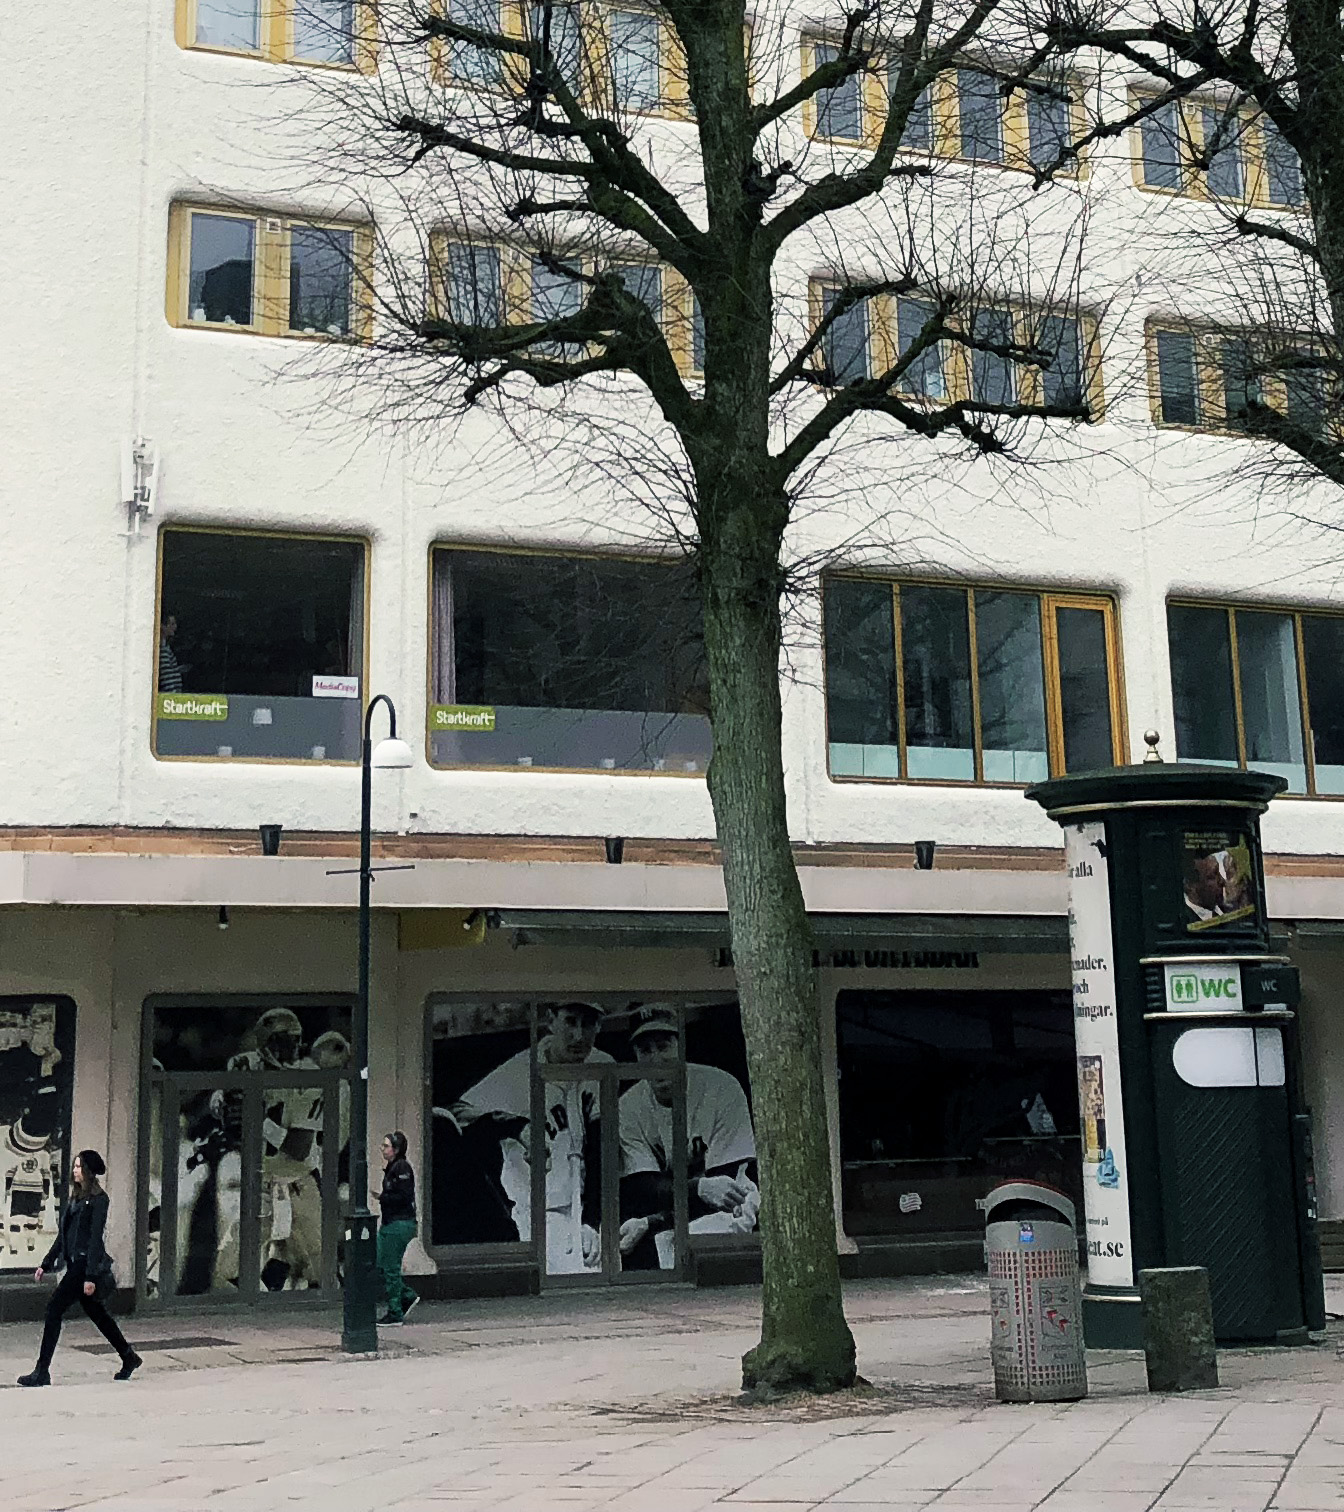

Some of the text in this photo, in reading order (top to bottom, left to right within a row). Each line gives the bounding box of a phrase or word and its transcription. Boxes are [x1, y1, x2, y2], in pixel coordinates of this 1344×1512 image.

[163, 699, 229, 716] Startkraft
[1200, 977, 1237, 999] WC
[1261, 979, 1278, 992] WC
